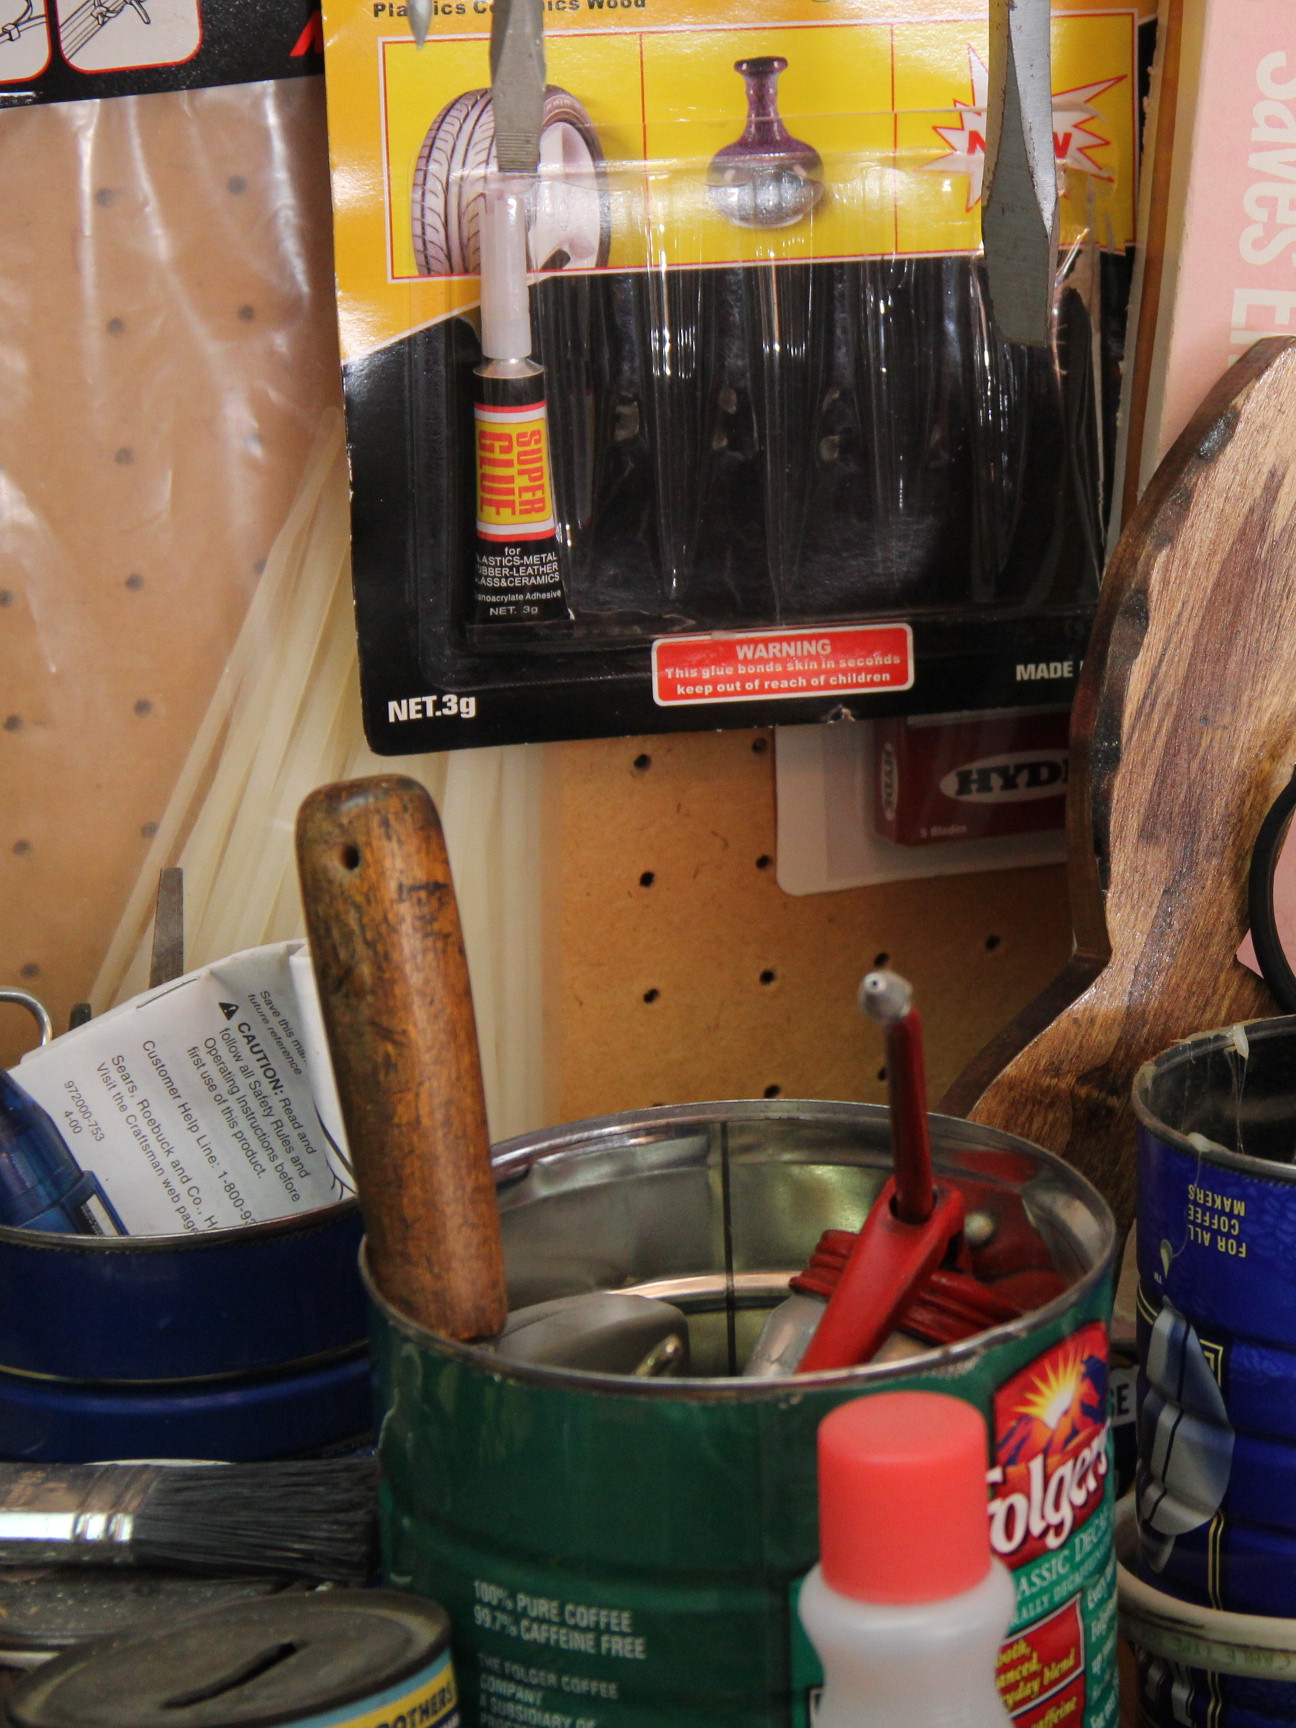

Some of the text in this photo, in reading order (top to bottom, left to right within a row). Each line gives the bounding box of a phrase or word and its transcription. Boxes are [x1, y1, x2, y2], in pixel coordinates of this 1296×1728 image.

[373, 1, 466, 17] Plaics
[478, 429, 516, 516] GLUE
[516, 428, 546, 516] SUPER
[504, 546, 521, 556] for
[489, 605, 538, 616] NET. 3g
[665, 653, 901, 680] This glue bonds skin in seconds
[736, 639, 831, 660] WARNING
[677, 670, 891, 696] keep out of reach of children
[1016, 661, 1074, 681] MADE
[387, 694, 477, 723] NET.3g
[260, 989, 281, 1018] Save
[267, 1026, 302, 1075] reference
[142, 1040, 221, 1169] Customer Help Line:
[219, 1027, 310, 1179] follow all Safety Rules and
[238, 1022, 317, 1155] CAUTION: Read and
[64, 1080, 105, 1142] 972000-753
[111, 1054, 192, 1185] Sears, Roebuck and
[187, 1046, 266, 1179] first use of this product.
[204, 1037, 301, 1203] Operating Instructions before
[96, 1062, 181, 1203] Visit the Craftsman web
[1188, 1183, 1246, 1217] MAKERS
[1188, 1204, 1240, 1236] COFFEE
[1187, 1224, 1247, 1258] FOR ALL
[516, 1592, 561, 1623] PURE
[565, 1602, 633, 1633] COFFEE
[520, 1618, 596, 1654] CAFFEINE
[601, 1634, 647, 1660] FREE
[480, 1674, 543, 1706] COMPANY
[504, 1660, 559, 1688] FOLGER
[561, 1675, 619, 1700] COFFEE
